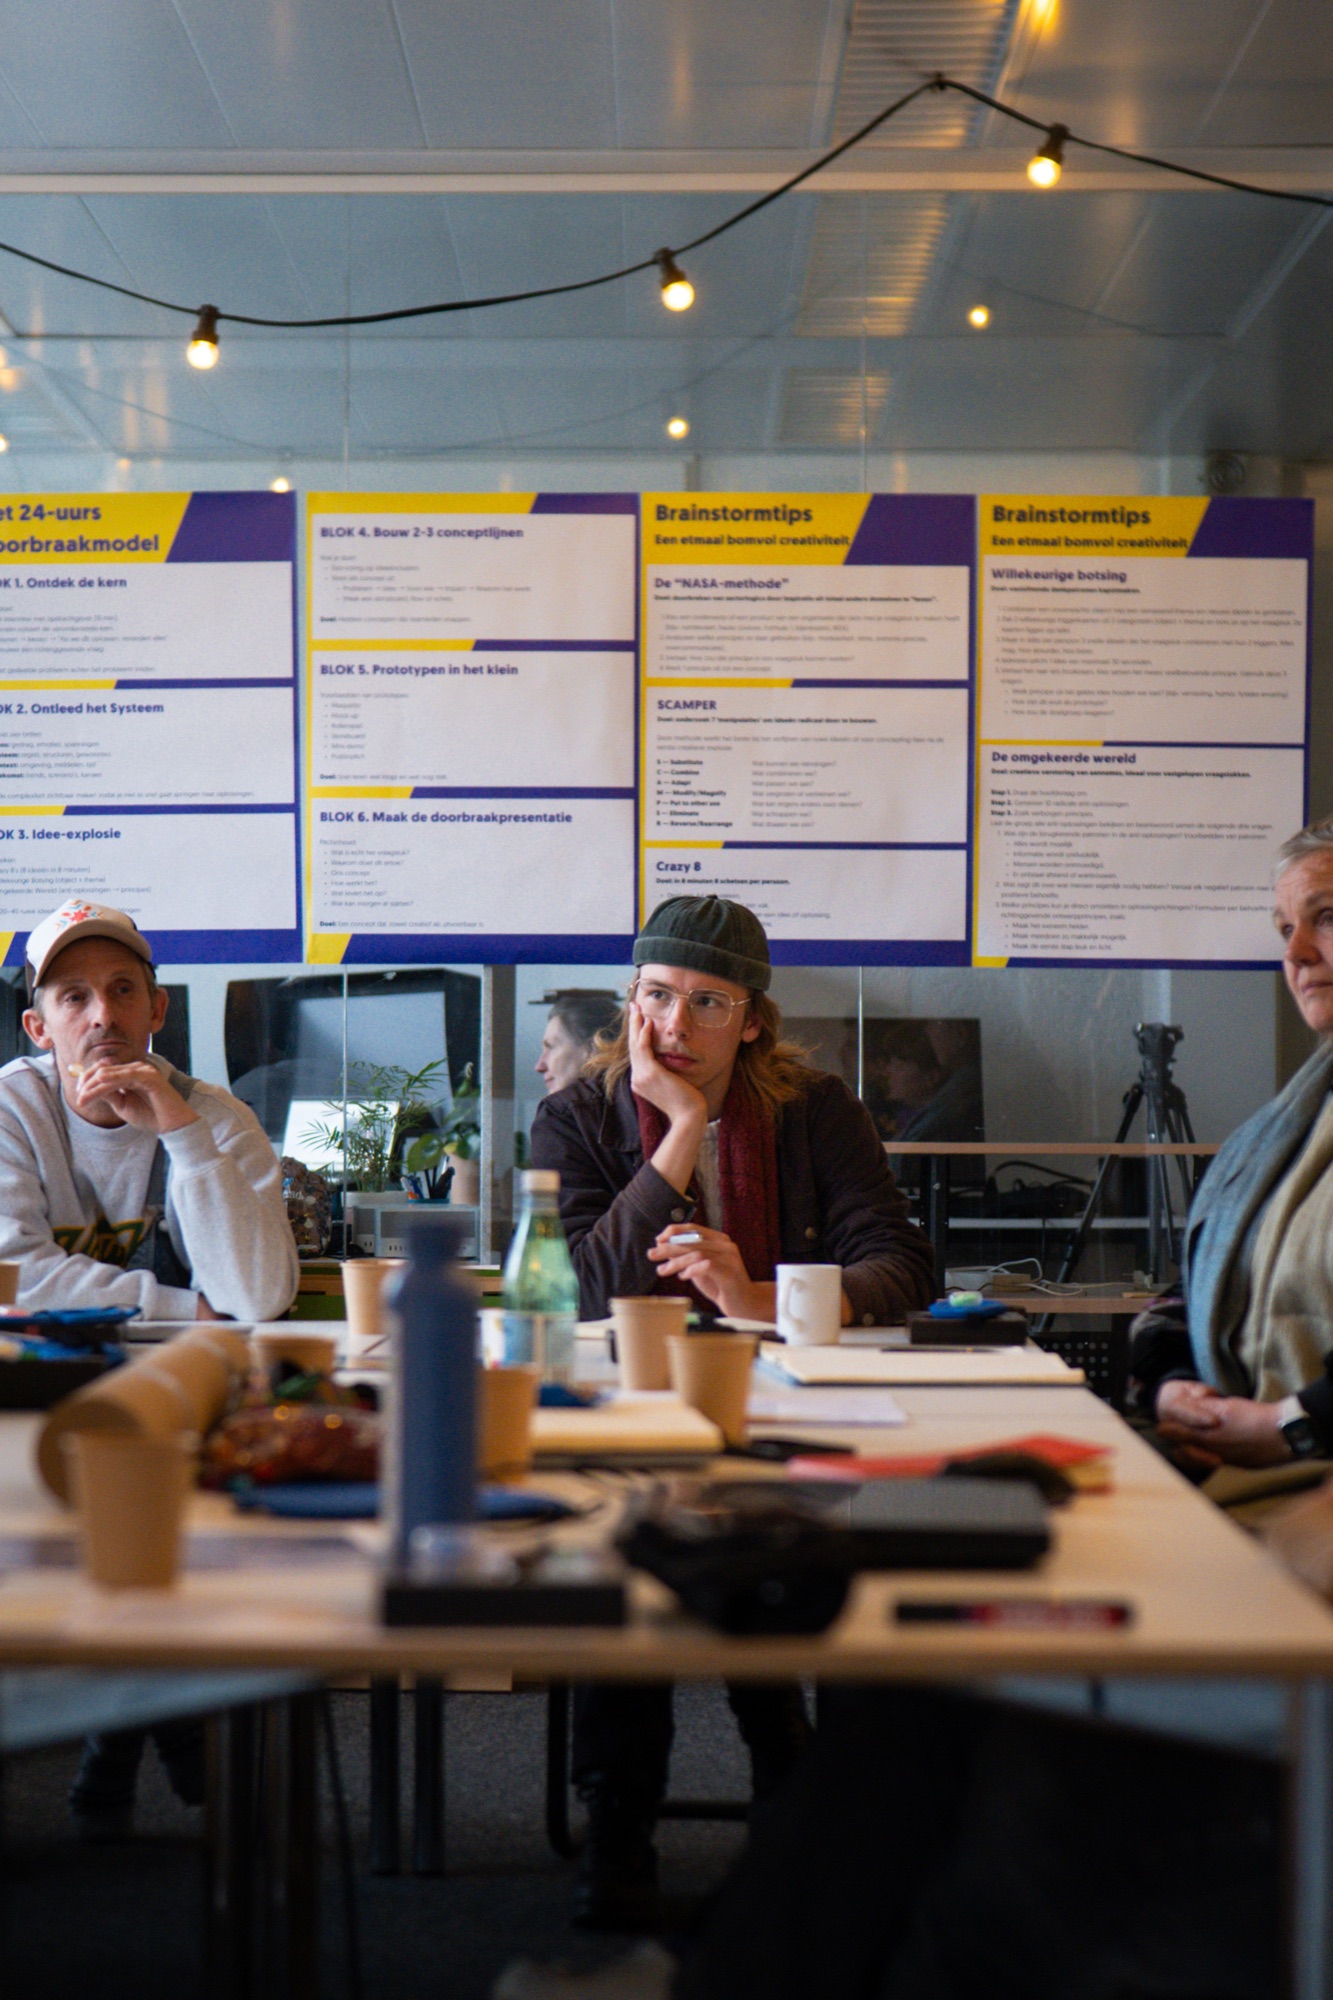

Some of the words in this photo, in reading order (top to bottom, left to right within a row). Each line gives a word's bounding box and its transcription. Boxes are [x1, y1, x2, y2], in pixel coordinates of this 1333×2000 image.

[20, 503, 102, 521] 24-uurs
[656, 504, 813, 524] Brainstormtips
[992, 505, 1151, 526] Brainstormtips
[320, 526, 355, 538] BLOK
[358, 526, 370, 538] 4.
[374, 526, 409, 538] Bouw
[413, 526, 434, 538] 2-3
[437, 526, 524, 540] conceptlijnen
[655, 533, 678, 545] Een
[681, 535, 724, 546] etmaal
[728, 534, 776, 546] bomvol
[779, 534, 850, 546] creativiteit
[992, 534, 1014, 547] Een
[1017, 536, 1061, 548] etmaal
[1064, 536, 1114, 548] bomvol
[1117, 537, 1188, 549] creativiteit
[27, 577, 75, 589] Ontdek
[79, 577, 94, 588] de
[98, 577, 127, 588] kern
[655, 577, 672, 589] De
[992, 568, 1075, 583] Willekeurige
[1077, 570, 1127, 584] botsing
[320, 664, 355, 675] BLOK
[358, 664, 370, 676] 5.
[373, 664, 446, 677] Prototypen
[449, 663, 460, 675] in
[463, 664, 484, 675] het
[487, 664, 518, 675] klein
[17, 703, 28, 715] 2.
[31, 703, 83, 715] Ontleed
[86, 702, 107, 714] het
[110, 702, 164, 715] Systeem
[657, 699, 717, 711] SCAMPER
[992, 751, 1008, 762] De
[1011, 752, 1090, 765] omgekeerde
[1092, 753, 1136, 764] wereld
[320, 811, 354, 823] BLOK
[358, 811, 370, 823] 6.
[373, 811, 408, 823] Maak
[412, 811, 427, 823] de
[430, 812, 573, 824] doorbraakpresentatie
[18, 829, 29, 840] 3.
[32, 828, 121, 841] Idee-explosie
[656, 860, 691, 874] Crazy
[693, 861, 701, 872] 8
